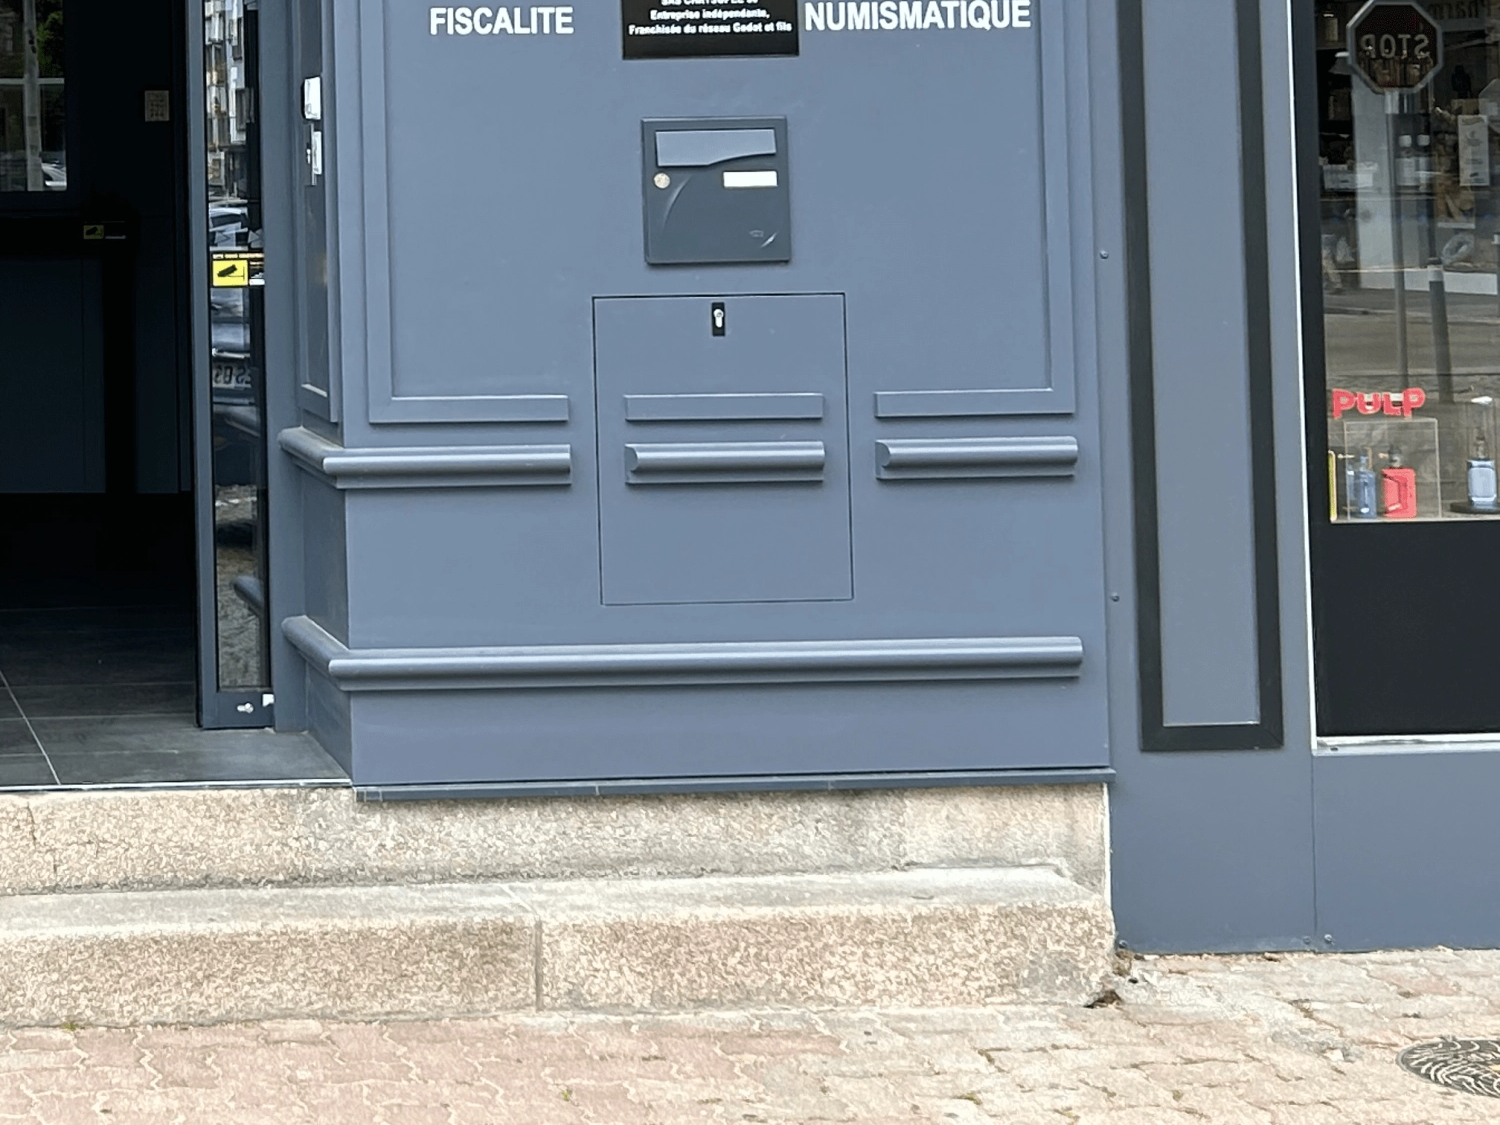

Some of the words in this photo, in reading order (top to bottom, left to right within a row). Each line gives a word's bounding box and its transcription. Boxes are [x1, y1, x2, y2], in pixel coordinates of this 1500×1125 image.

[430, 6, 574, 35] FISCALITE
[805, 0, 1031, 31] NUMISMATIQUE
[1332, 388, 1426, 419] PULP
